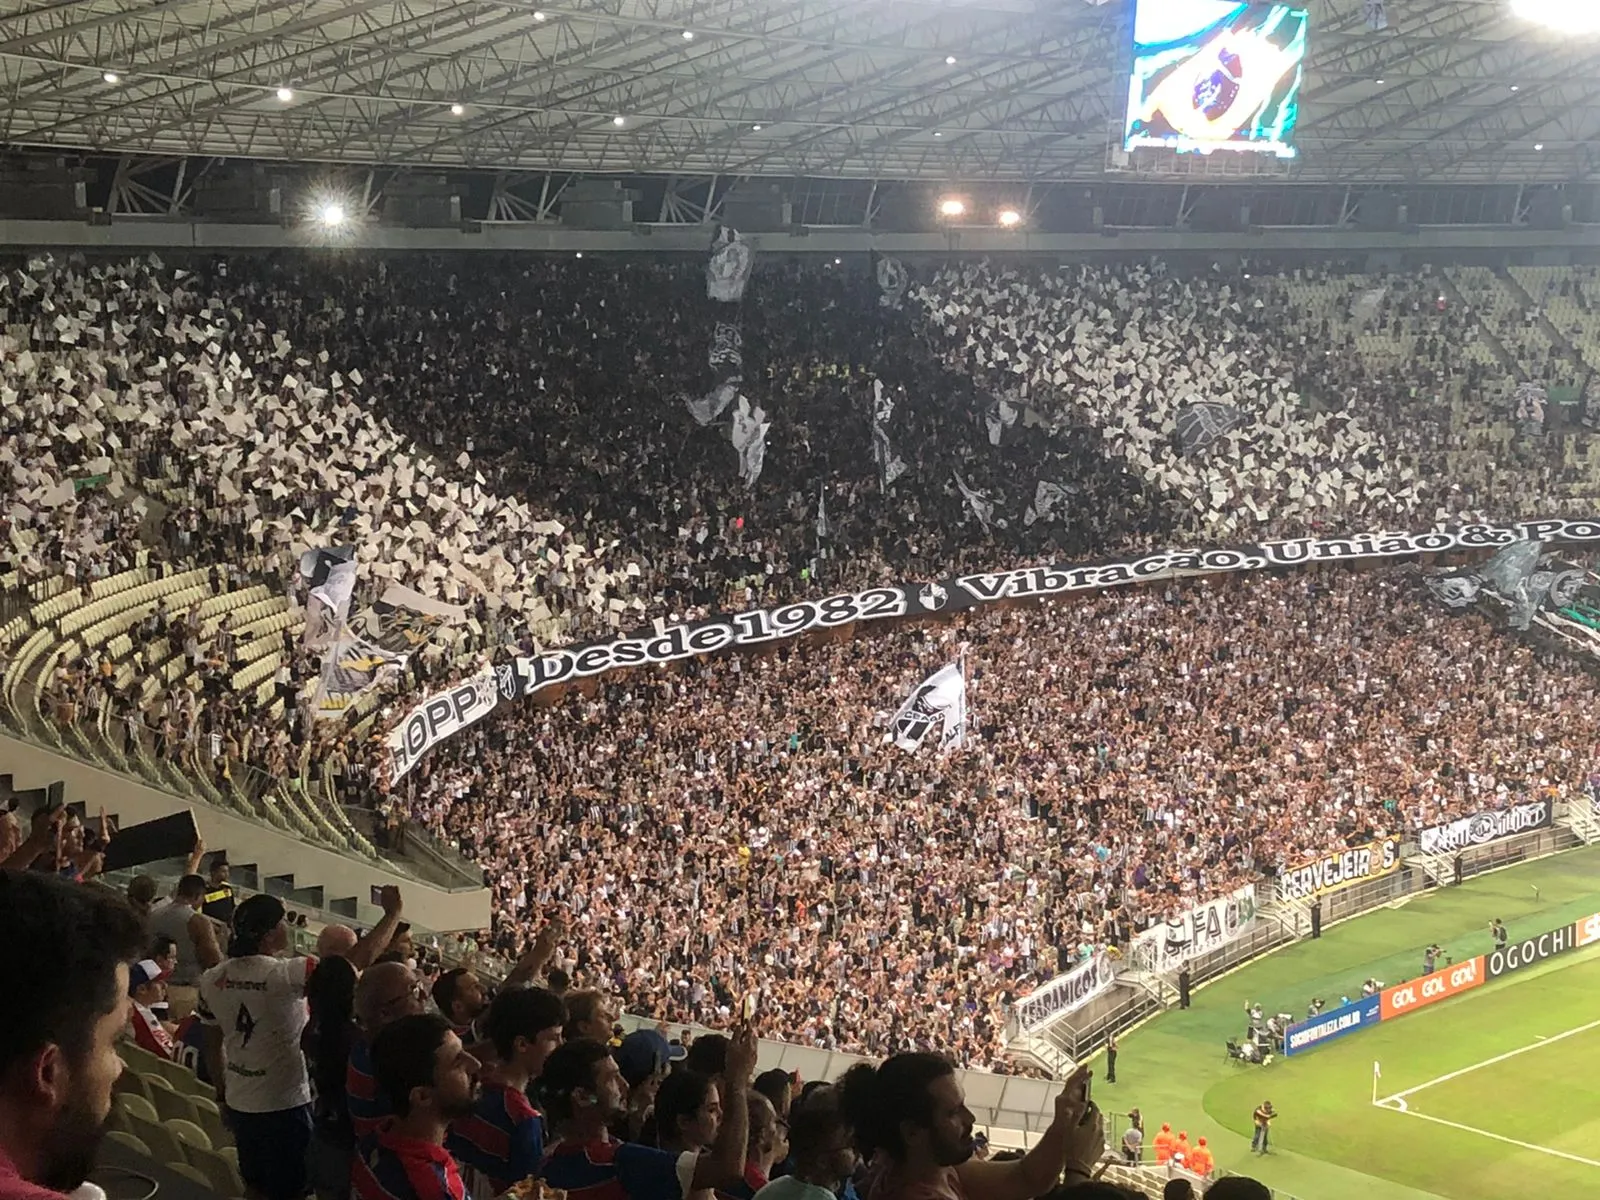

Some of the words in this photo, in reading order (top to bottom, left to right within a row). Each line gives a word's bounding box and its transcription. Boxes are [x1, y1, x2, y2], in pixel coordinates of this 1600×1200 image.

[526, 624, 732, 694] Desde
[734, 588, 906, 643] 1982
[1260, 531, 1455, 563] União
[1457, 524, 1517, 547] &
[1490, 926, 1572, 975] OGOCHI
[1392, 986, 1417, 1009] GOL
[1421, 976, 1446, 998] GOL
[235, 1002, 259, 1048] 4
